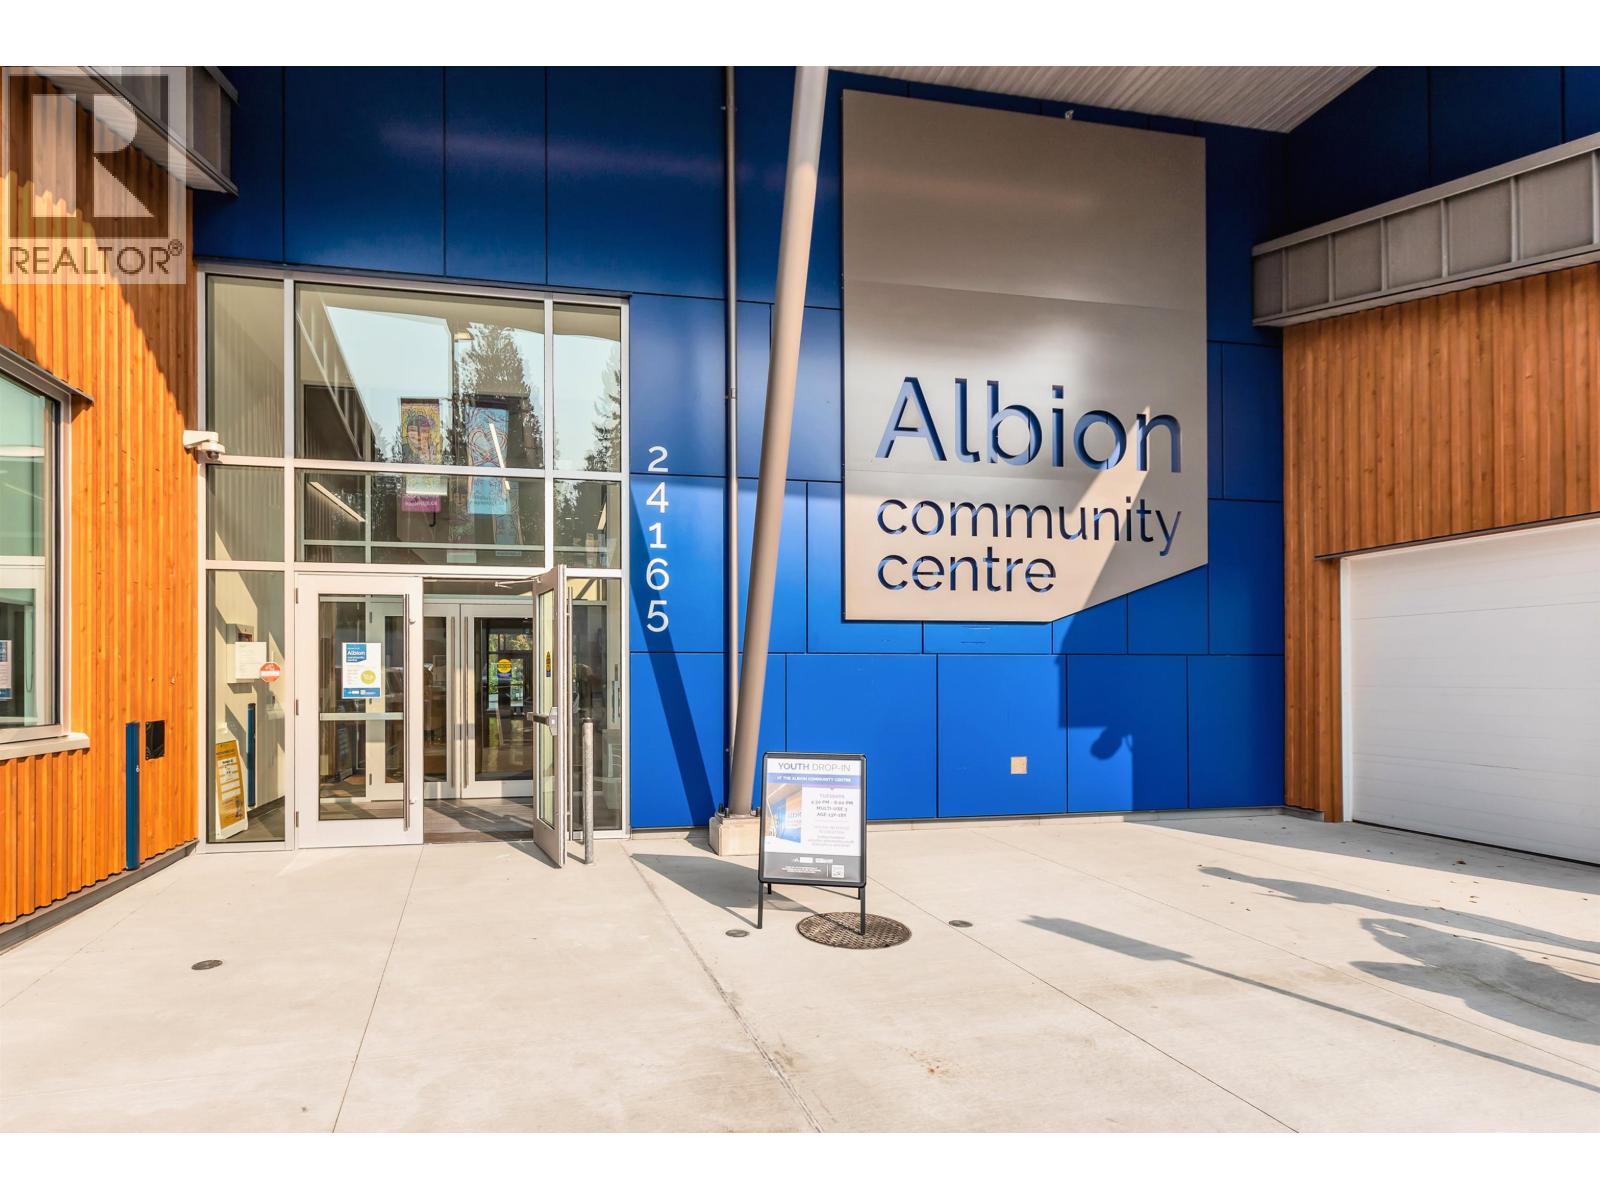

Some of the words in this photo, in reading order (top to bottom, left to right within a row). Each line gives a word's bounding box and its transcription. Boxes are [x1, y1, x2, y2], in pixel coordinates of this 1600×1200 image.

[875, 376, 1182, 473] Albion
[645, 445, 670, 632] 24165
[877, 496, 1182, 556] community
[877, 547, 1057, 592] centre
[812, 763, 851, 772] DROP-IN
